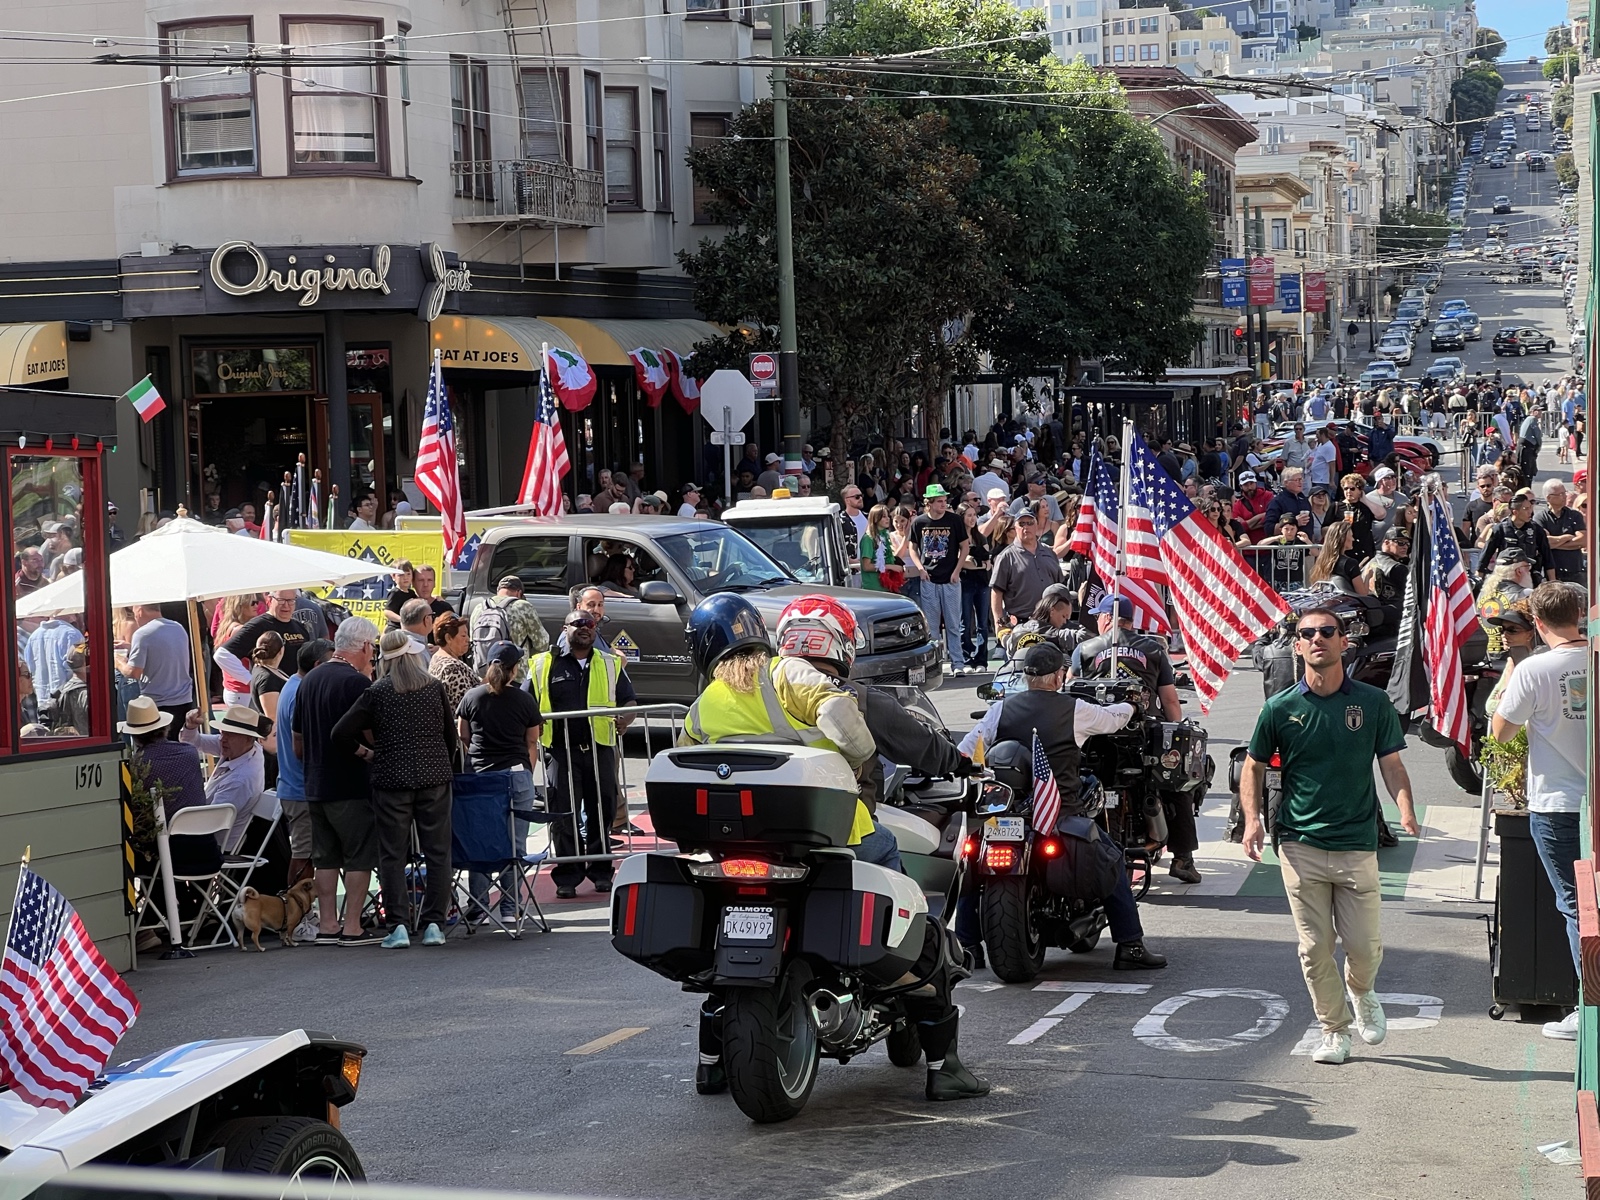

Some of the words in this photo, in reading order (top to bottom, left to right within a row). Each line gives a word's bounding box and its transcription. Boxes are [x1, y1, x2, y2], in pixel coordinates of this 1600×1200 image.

[210, 240, 391, 306] Original
[463, 350, 480, 362] AT
[482, 351, 519, 363] JOE'S
[27, 363, 39, 375] EAT
[40, 361, 48, 373] AT
[48, 359, 66, 372] JOE'S
[217, 363, 263, 384] Original
[1101, 646, 1140, 660] VEERAN
[75, 763, 103, 791] 1570
[726, 921, 772, 935] DK49Y97
